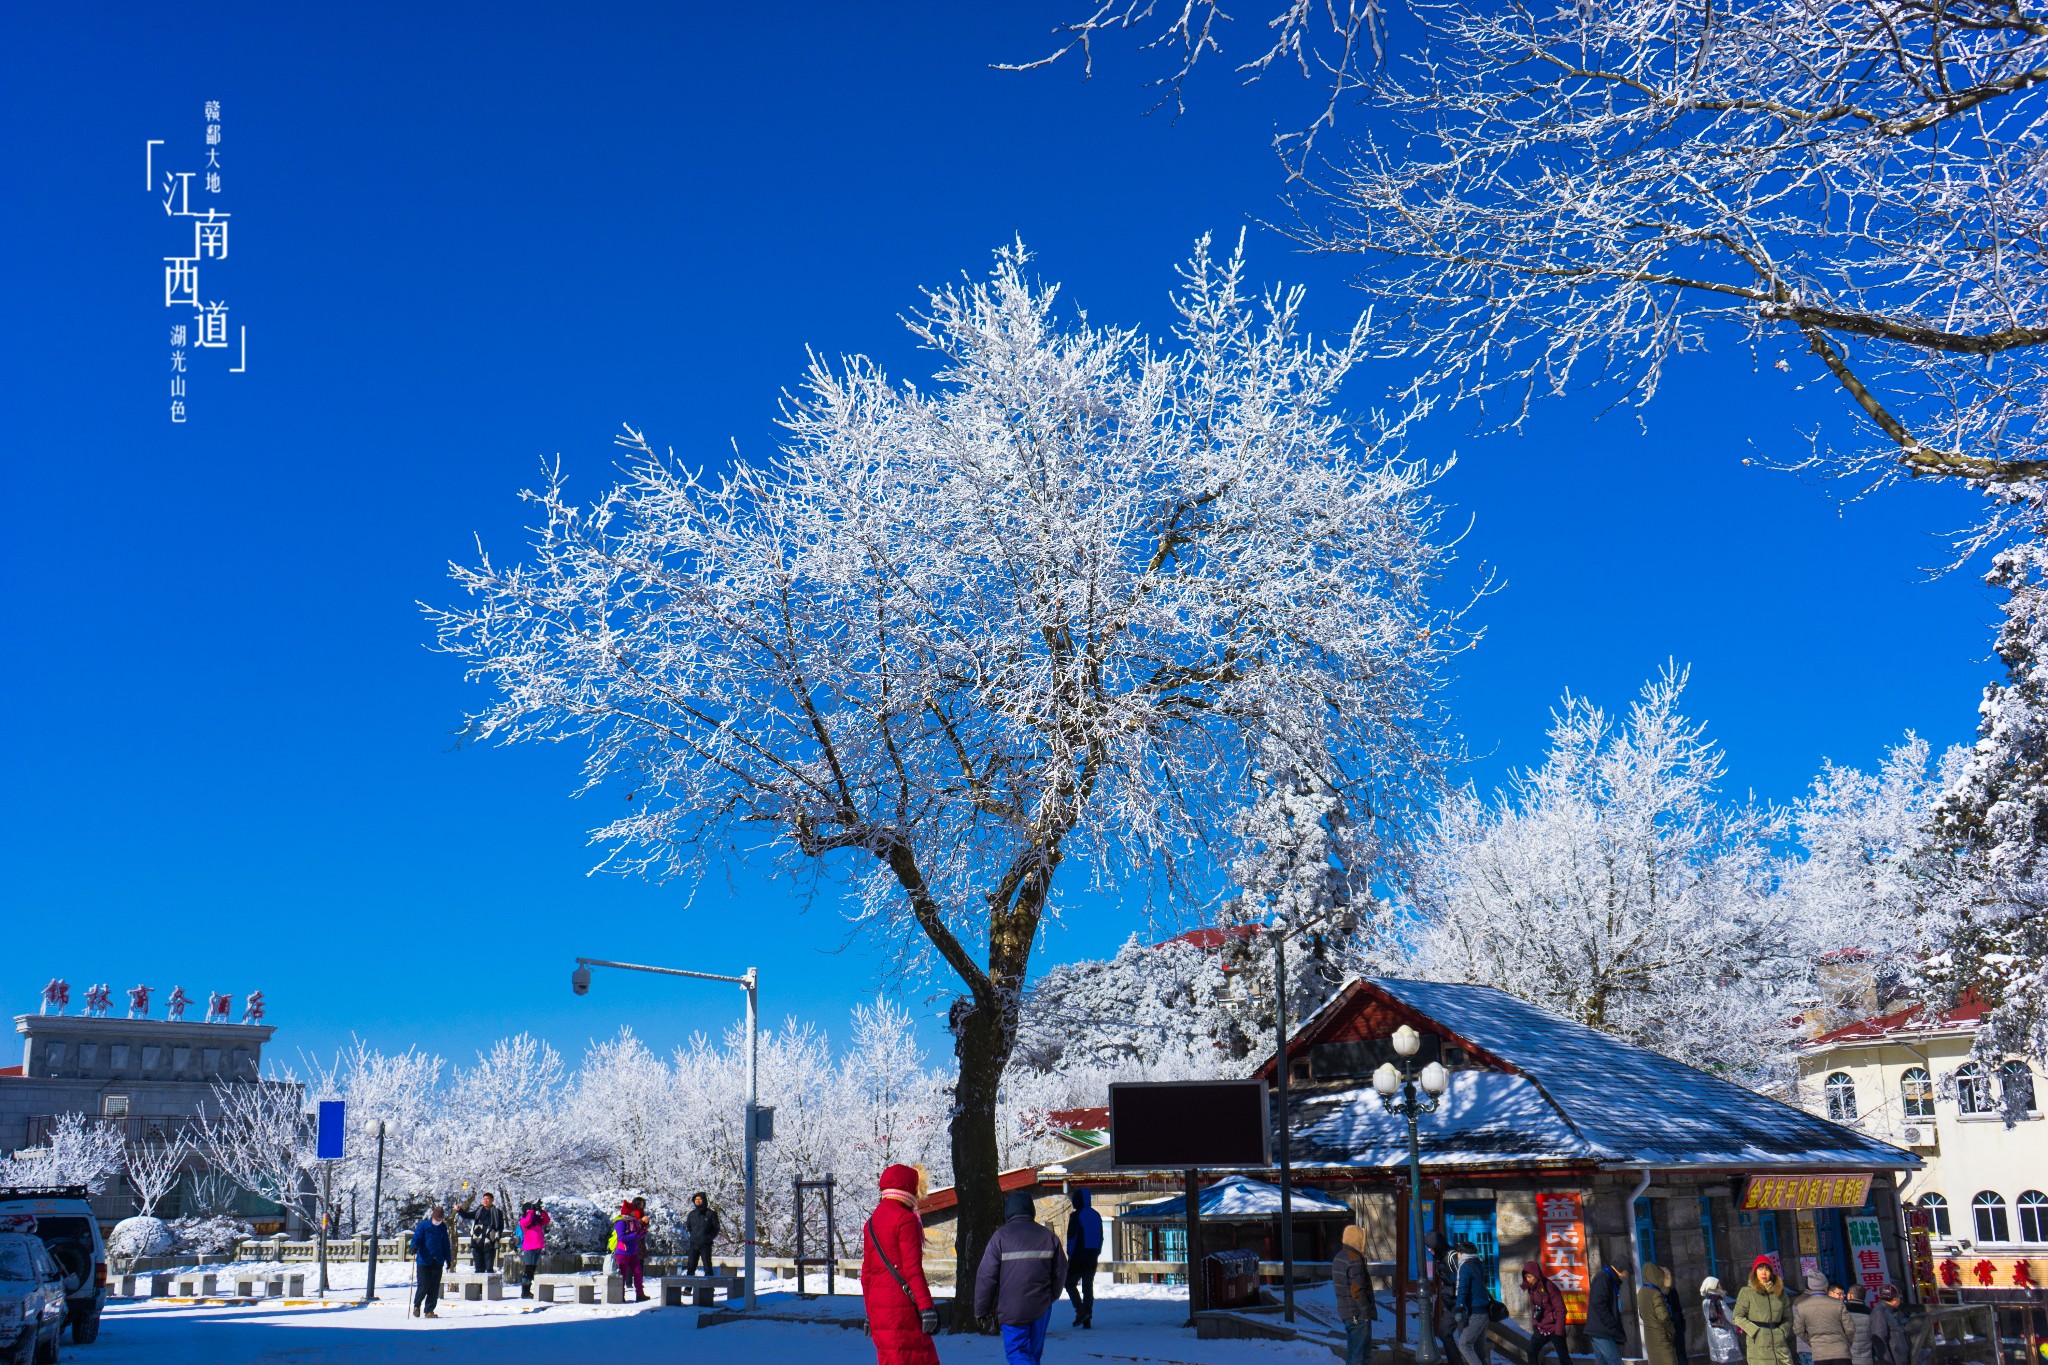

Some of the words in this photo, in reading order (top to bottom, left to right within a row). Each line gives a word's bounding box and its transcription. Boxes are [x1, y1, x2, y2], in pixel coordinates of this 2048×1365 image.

[1542, 1198, 1583, 1291] 益民五金
[1857, 1249, 1885, 1310] 售票
